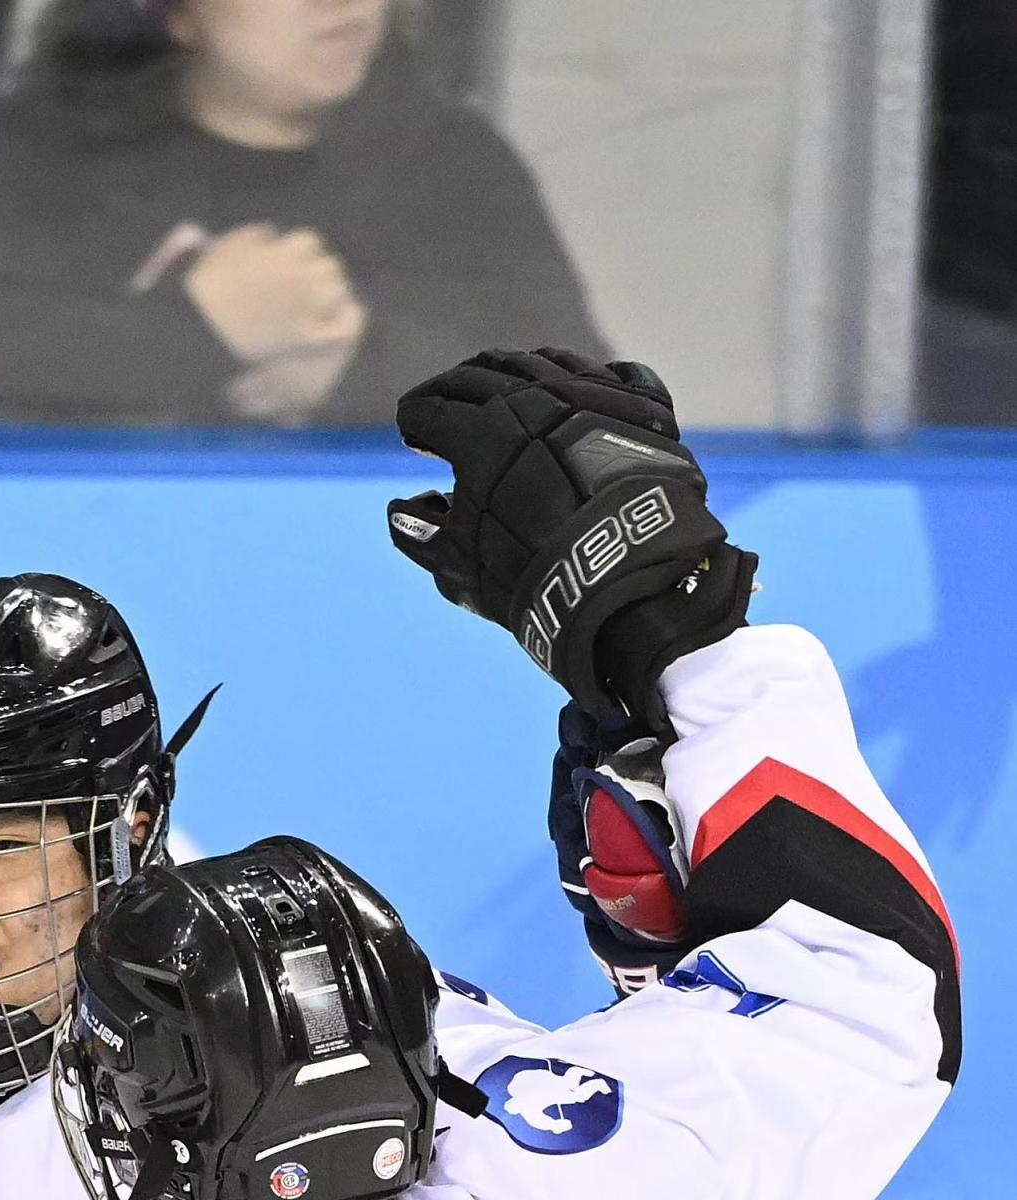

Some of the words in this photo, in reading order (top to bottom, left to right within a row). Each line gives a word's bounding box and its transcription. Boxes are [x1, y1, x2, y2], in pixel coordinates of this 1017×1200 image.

[520, 485, 676, 674] BAUE
[100, 692, 147, 727] BAUER
[80, 1002, 124, 1053] BAUER
